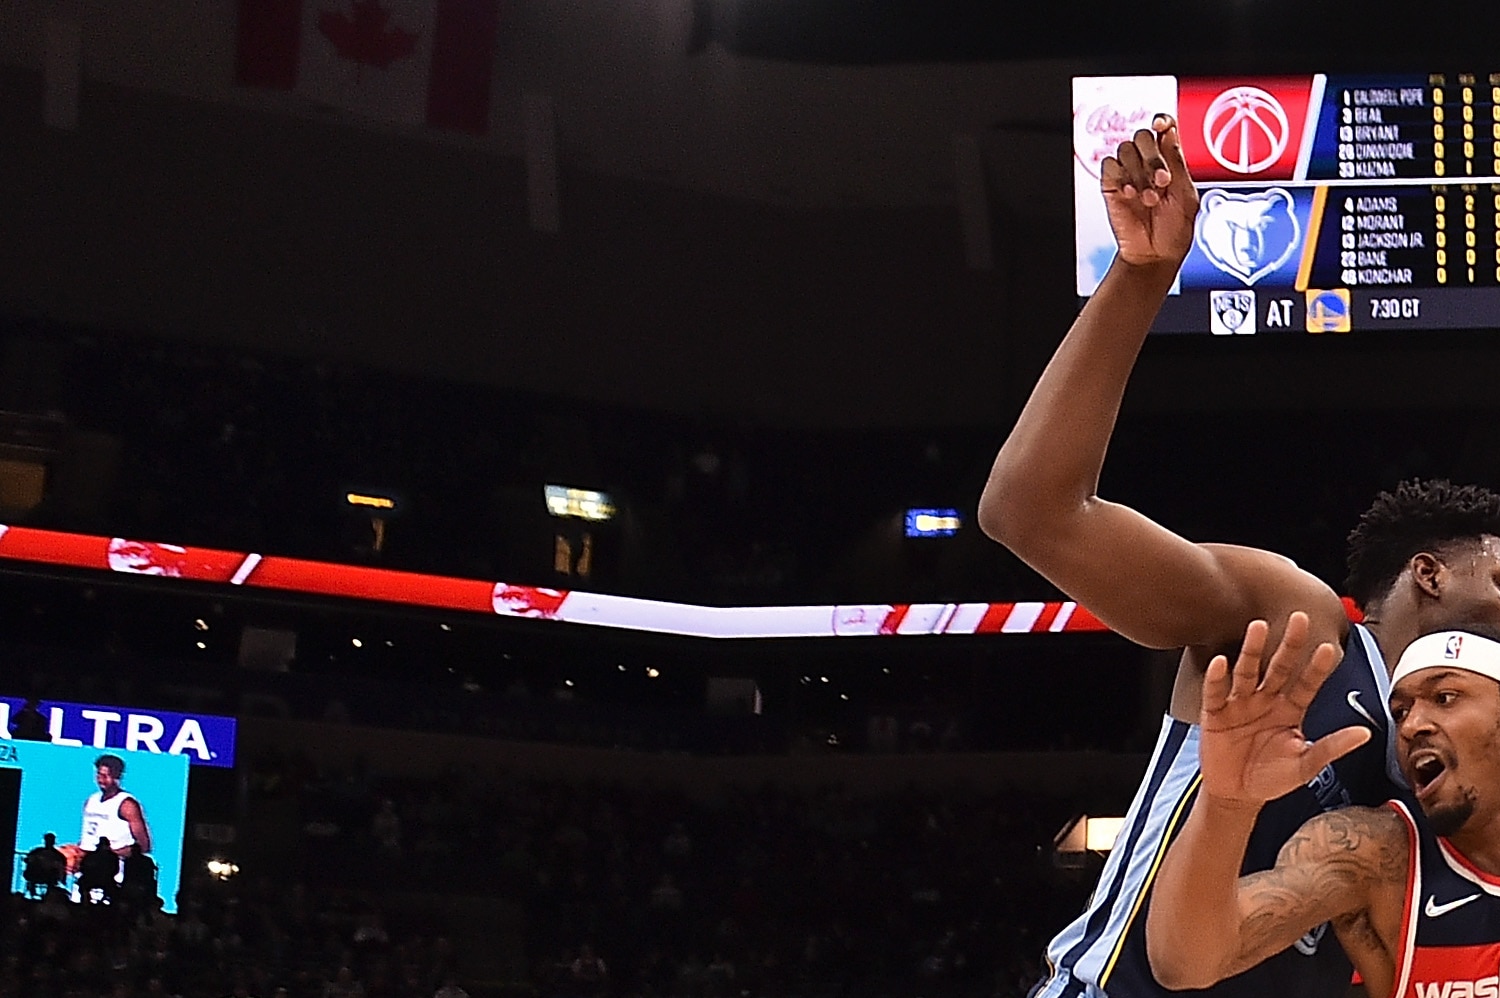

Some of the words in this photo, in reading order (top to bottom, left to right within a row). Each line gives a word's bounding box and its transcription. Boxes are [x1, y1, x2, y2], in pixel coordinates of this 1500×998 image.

[1355, 125, 1398, 141] BRYANT
[1356, 161, 1395, 177] KUZMA
[1357, 197, 1397, 212] ADAMS
[1465, 195, 1474, 211] 2
[1341, 215, 1355, 231] 12
[1357, 214, 1404, 230] MORANT
[1436, 214, 1445, 229] 3
[1357, 232, 1408, 248] JACKSON
[1341, 251, 1357, 267] 22
[1357, 250, 1388, 267] BANE
[1358, 268, 1412, 284] KONCHAR
[1266, 300, 1294, 327] AT
[1402, 299, 1420, 317] CT
